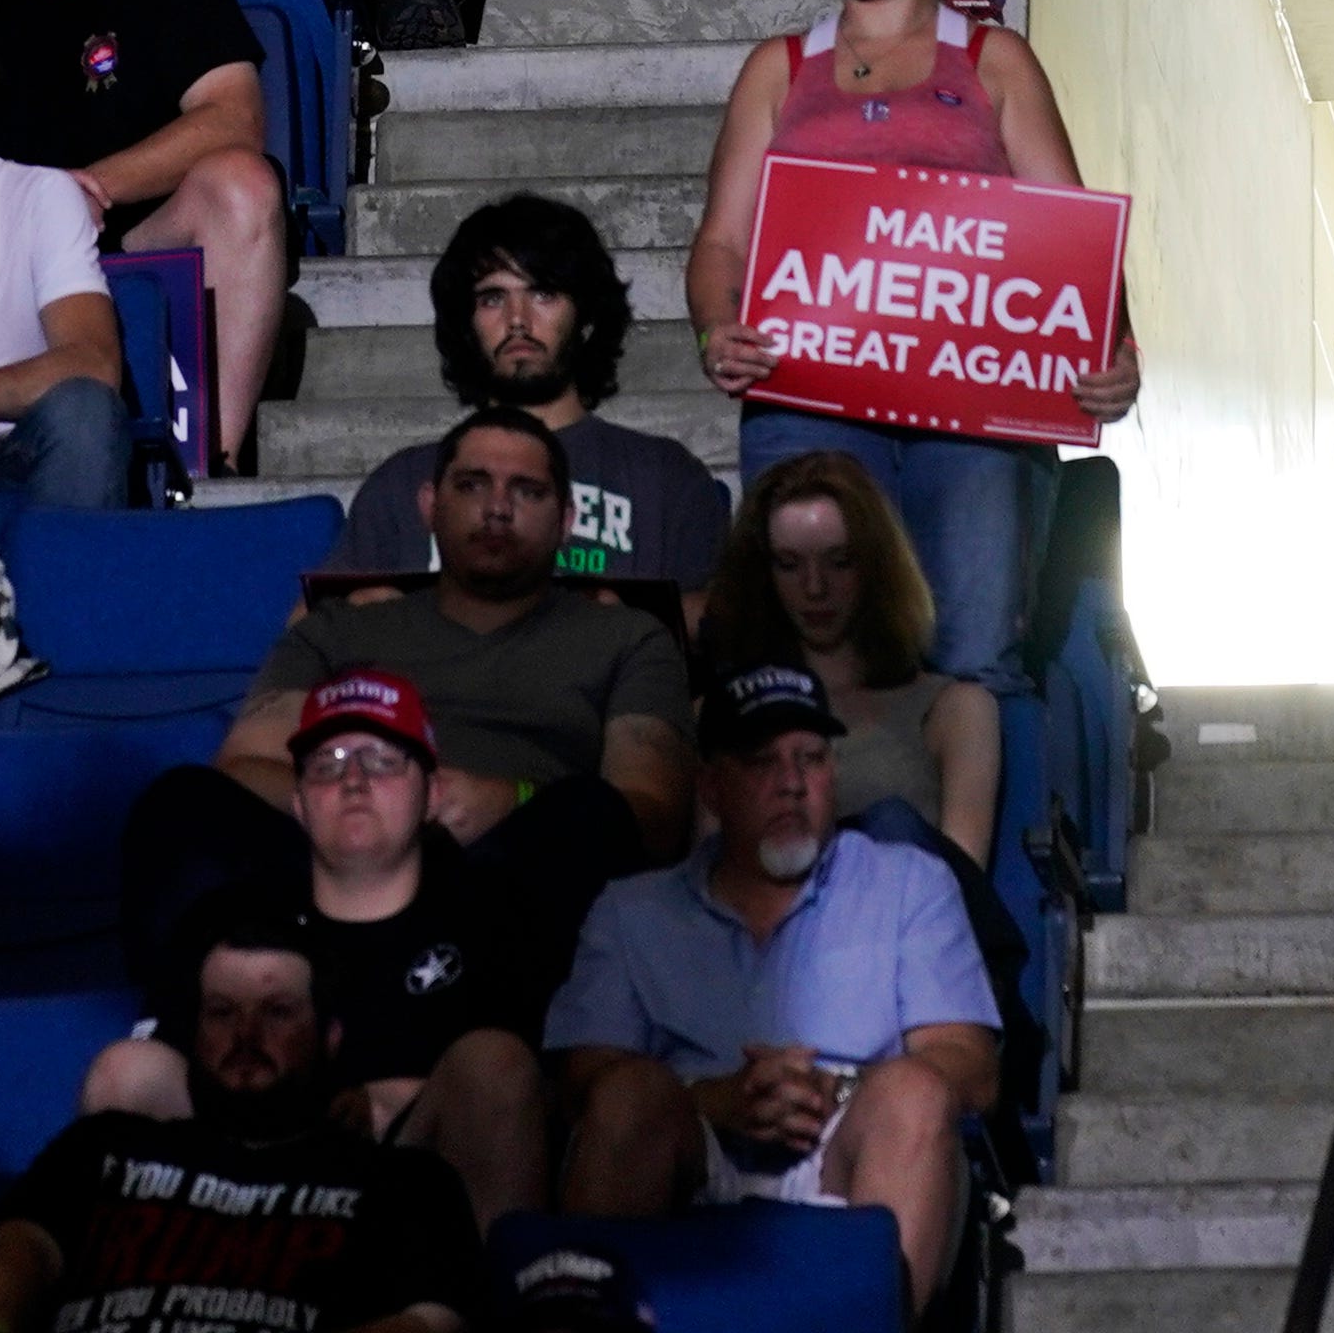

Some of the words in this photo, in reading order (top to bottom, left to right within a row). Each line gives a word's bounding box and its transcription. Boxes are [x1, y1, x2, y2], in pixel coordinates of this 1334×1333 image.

[864, 205, 1008, 261] MAKE
[761, 249, 1094, 342] AMERICA
[756, 317, 919, 374] GREAT
[120, 1156, 186, 1201] YOU
[187, 1171, 287, 1217] DON'T
[291, 1182, 364, 1220] LIKE
[98, 1285, 157, 1323] YOU
[162, 1283, 322, 1333] PROBABLY
